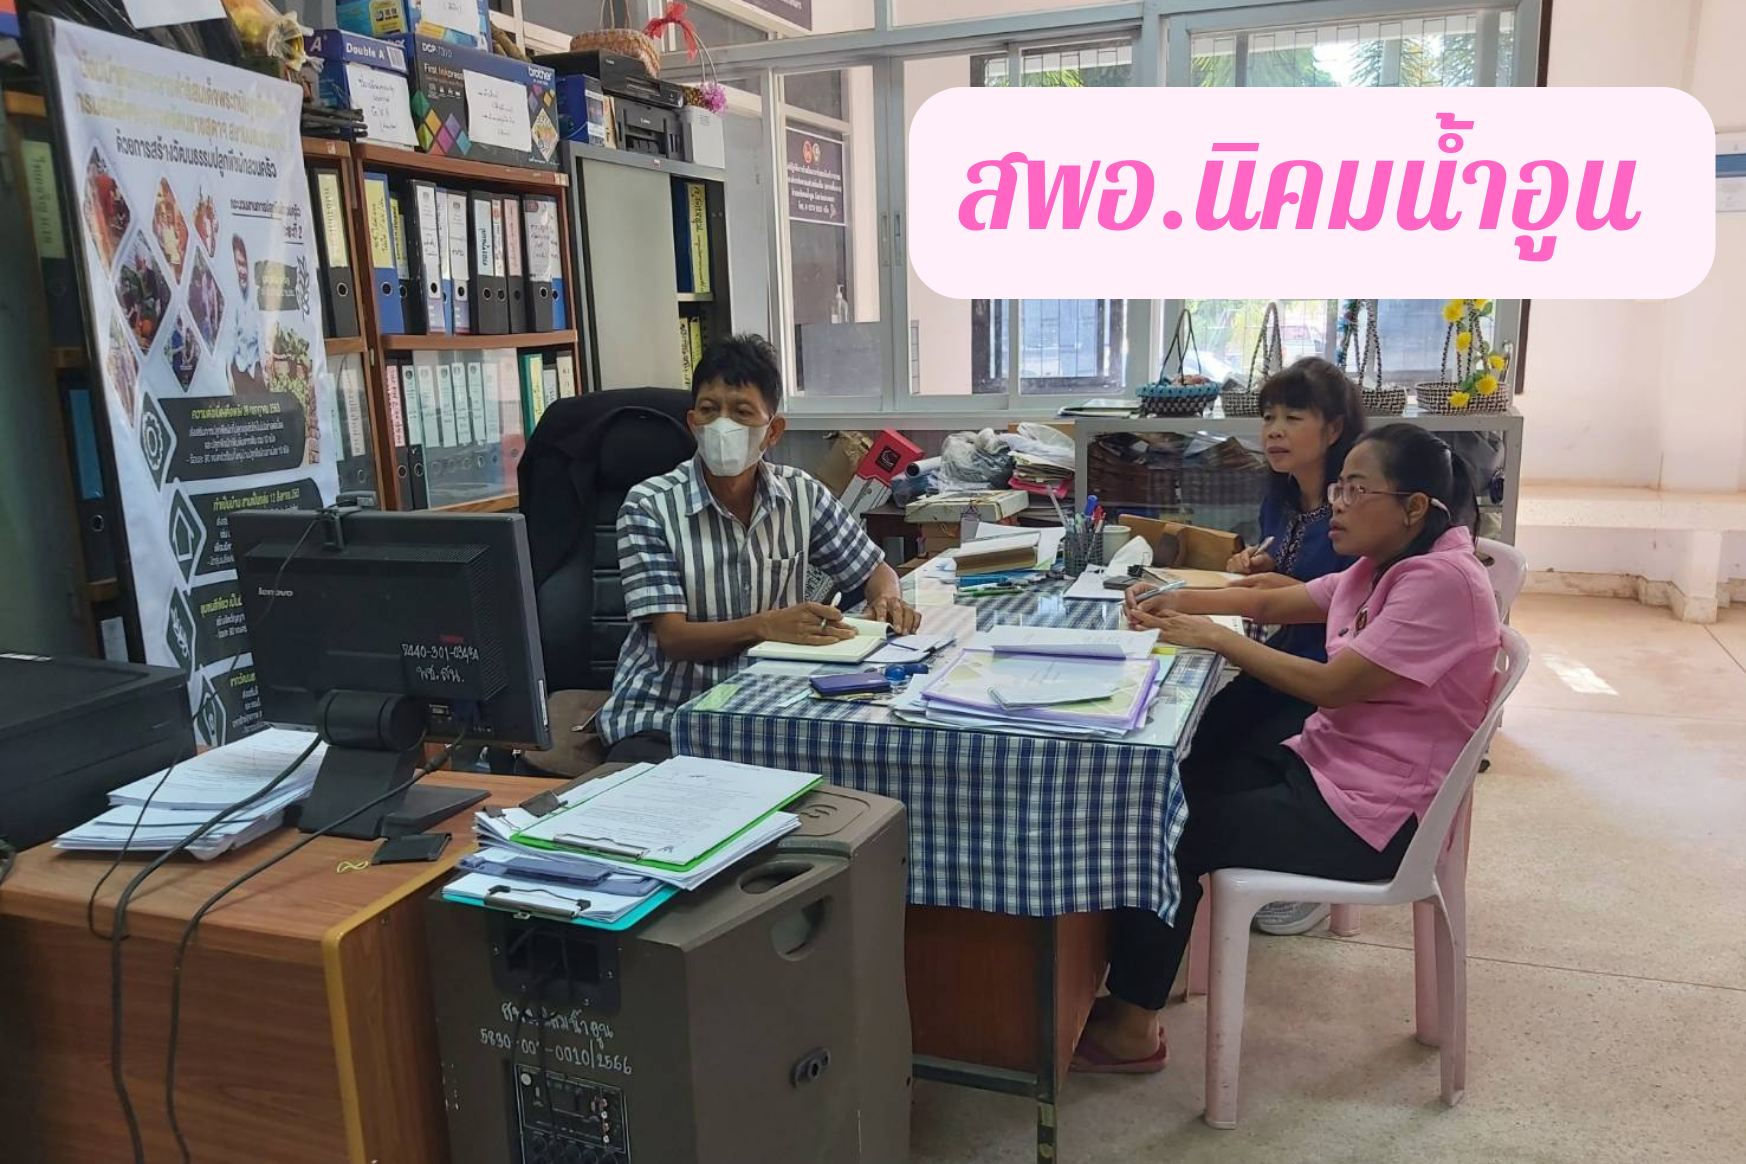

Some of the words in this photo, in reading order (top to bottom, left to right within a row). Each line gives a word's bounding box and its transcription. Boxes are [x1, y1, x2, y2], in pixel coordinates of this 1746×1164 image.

[345, 43, 376, 58] Double
[378, 49, 385, 60] A
[528, 65, 552, 80] brother
[258, 586, 294, 597] lenovo
